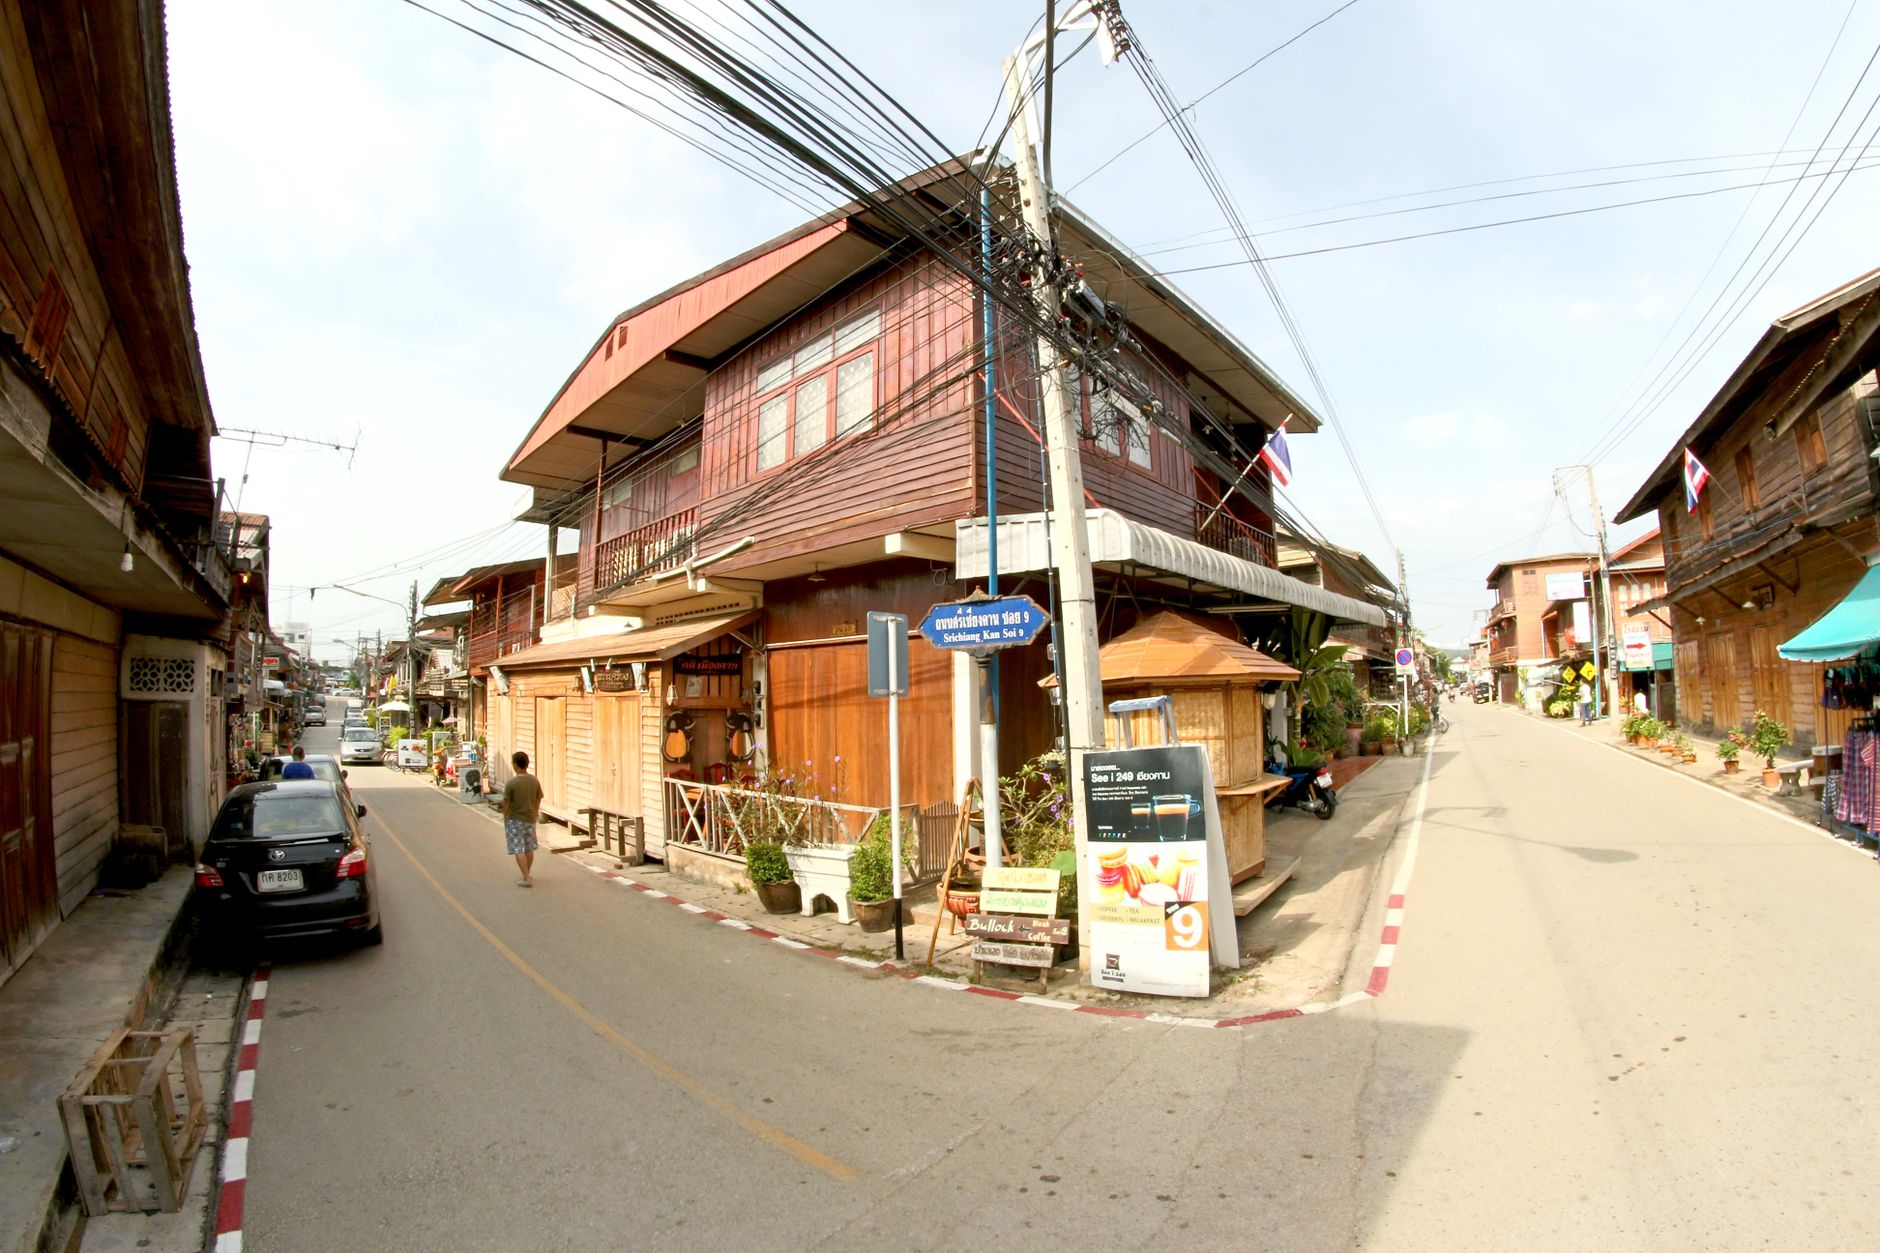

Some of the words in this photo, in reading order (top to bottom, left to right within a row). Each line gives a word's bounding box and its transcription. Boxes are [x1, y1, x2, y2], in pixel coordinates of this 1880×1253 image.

[1002, 611, 1021, 624] ซอย
[1024, 611, 1029, 623] 9
[943, 631, 981, 644] Srichiang
[983, 630, 1000, 640] Kan
[1003, 628, 1016, 638] Soi
[1091, 773, 1109, 783] See
[1116, 772, 1133, 782] 249
[1136, 771, 1170, 781] เชียงคาน
[277, 871, 298, 882] 8203
[1172, 905, 1203, 948] 9
[1028, 932, 1051, 942] Coffee
